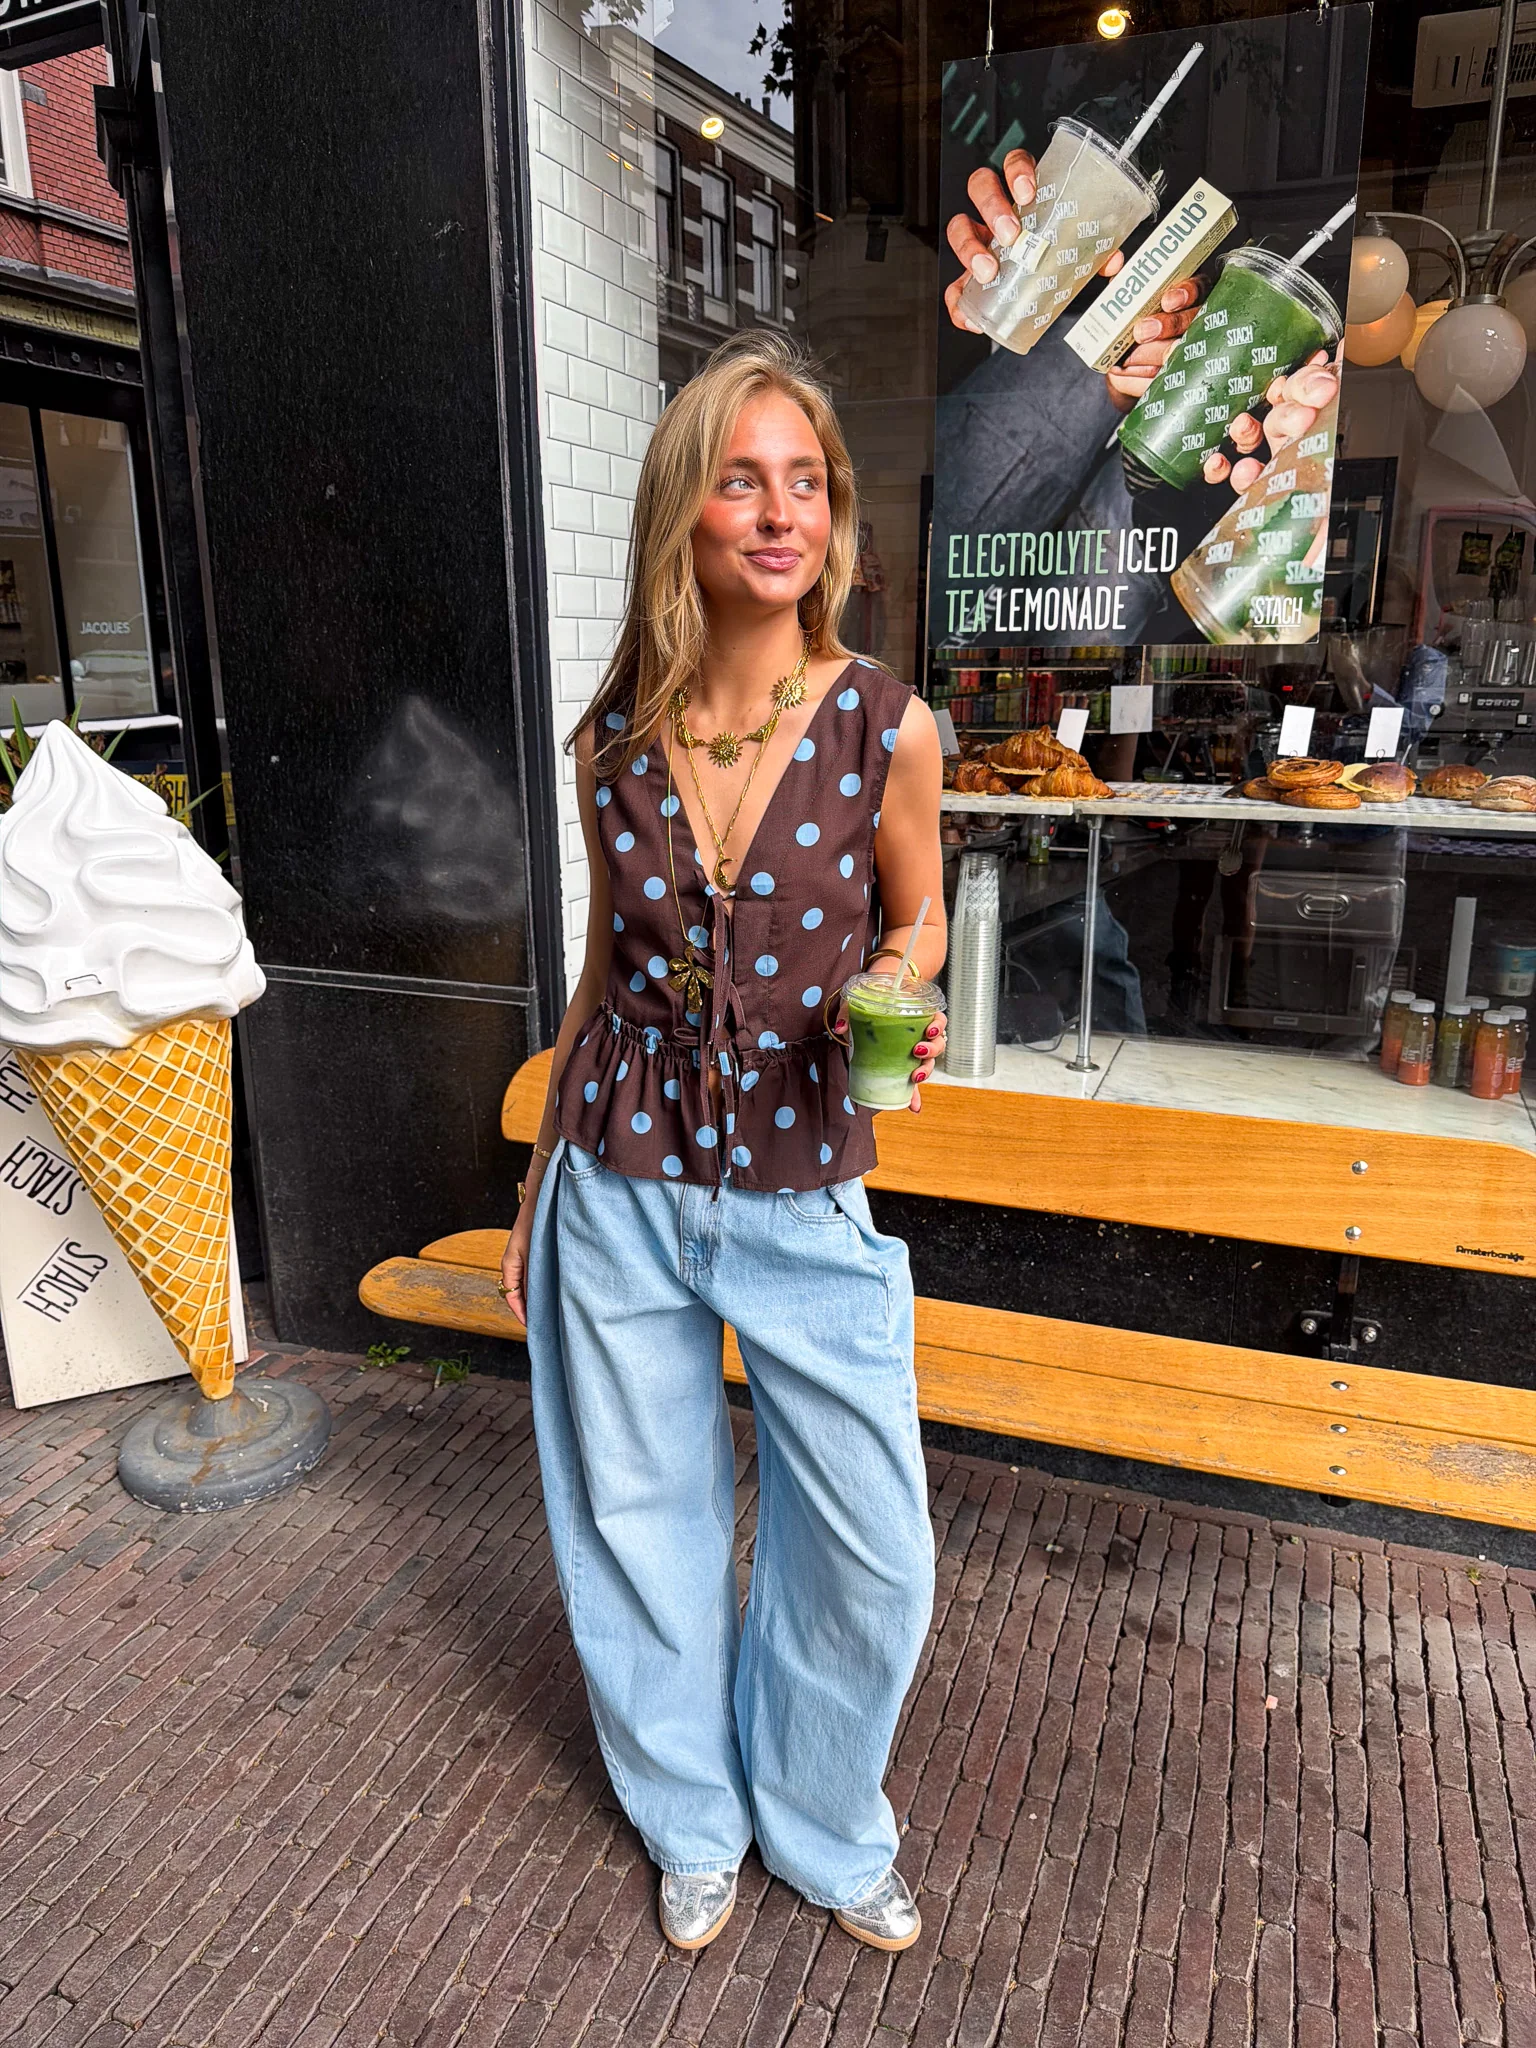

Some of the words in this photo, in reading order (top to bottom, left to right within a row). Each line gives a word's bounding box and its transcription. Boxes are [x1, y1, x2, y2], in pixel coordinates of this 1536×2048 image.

[1076, 219, 1100, 239] STACH
[1056, 247, 1079, 266] STACH
[1095, 236, 1115, 255] STACH
[1203, 308, 1228, 331] STACH
[1226, 324, 1254, 347] STACH
[1184, 339, 1207, 362] STACH
[1251, 345, 1278, 366] STACH
[1204, 355, 1231, 377] STACH
[1164, 369, 1186, 391] STACH
[1228, 374, 1254, 396] STACH
[1144, 398, 1165, 420] STACH
[1205, 403, 1230, 425] STACH
[1182, 432, 1206, 452] STACH
[1296, 431, 1329, 459] STACH
[1265, 468, 1297, 496] STACH
[1290, 491, 1328, 519] STACH
[948, 529, 1111, 579] ELECTROLYTE
[1117, 526, 1179, 574] ICED
[945, 588, 987, 633] TEA
[994, 585, 1129, 633] LEMONADE
[1252, 596, 1304, 628] STACH
[79, 621, 132, 635] JACQUES
[19, 1238, 109, 1323] STACH
